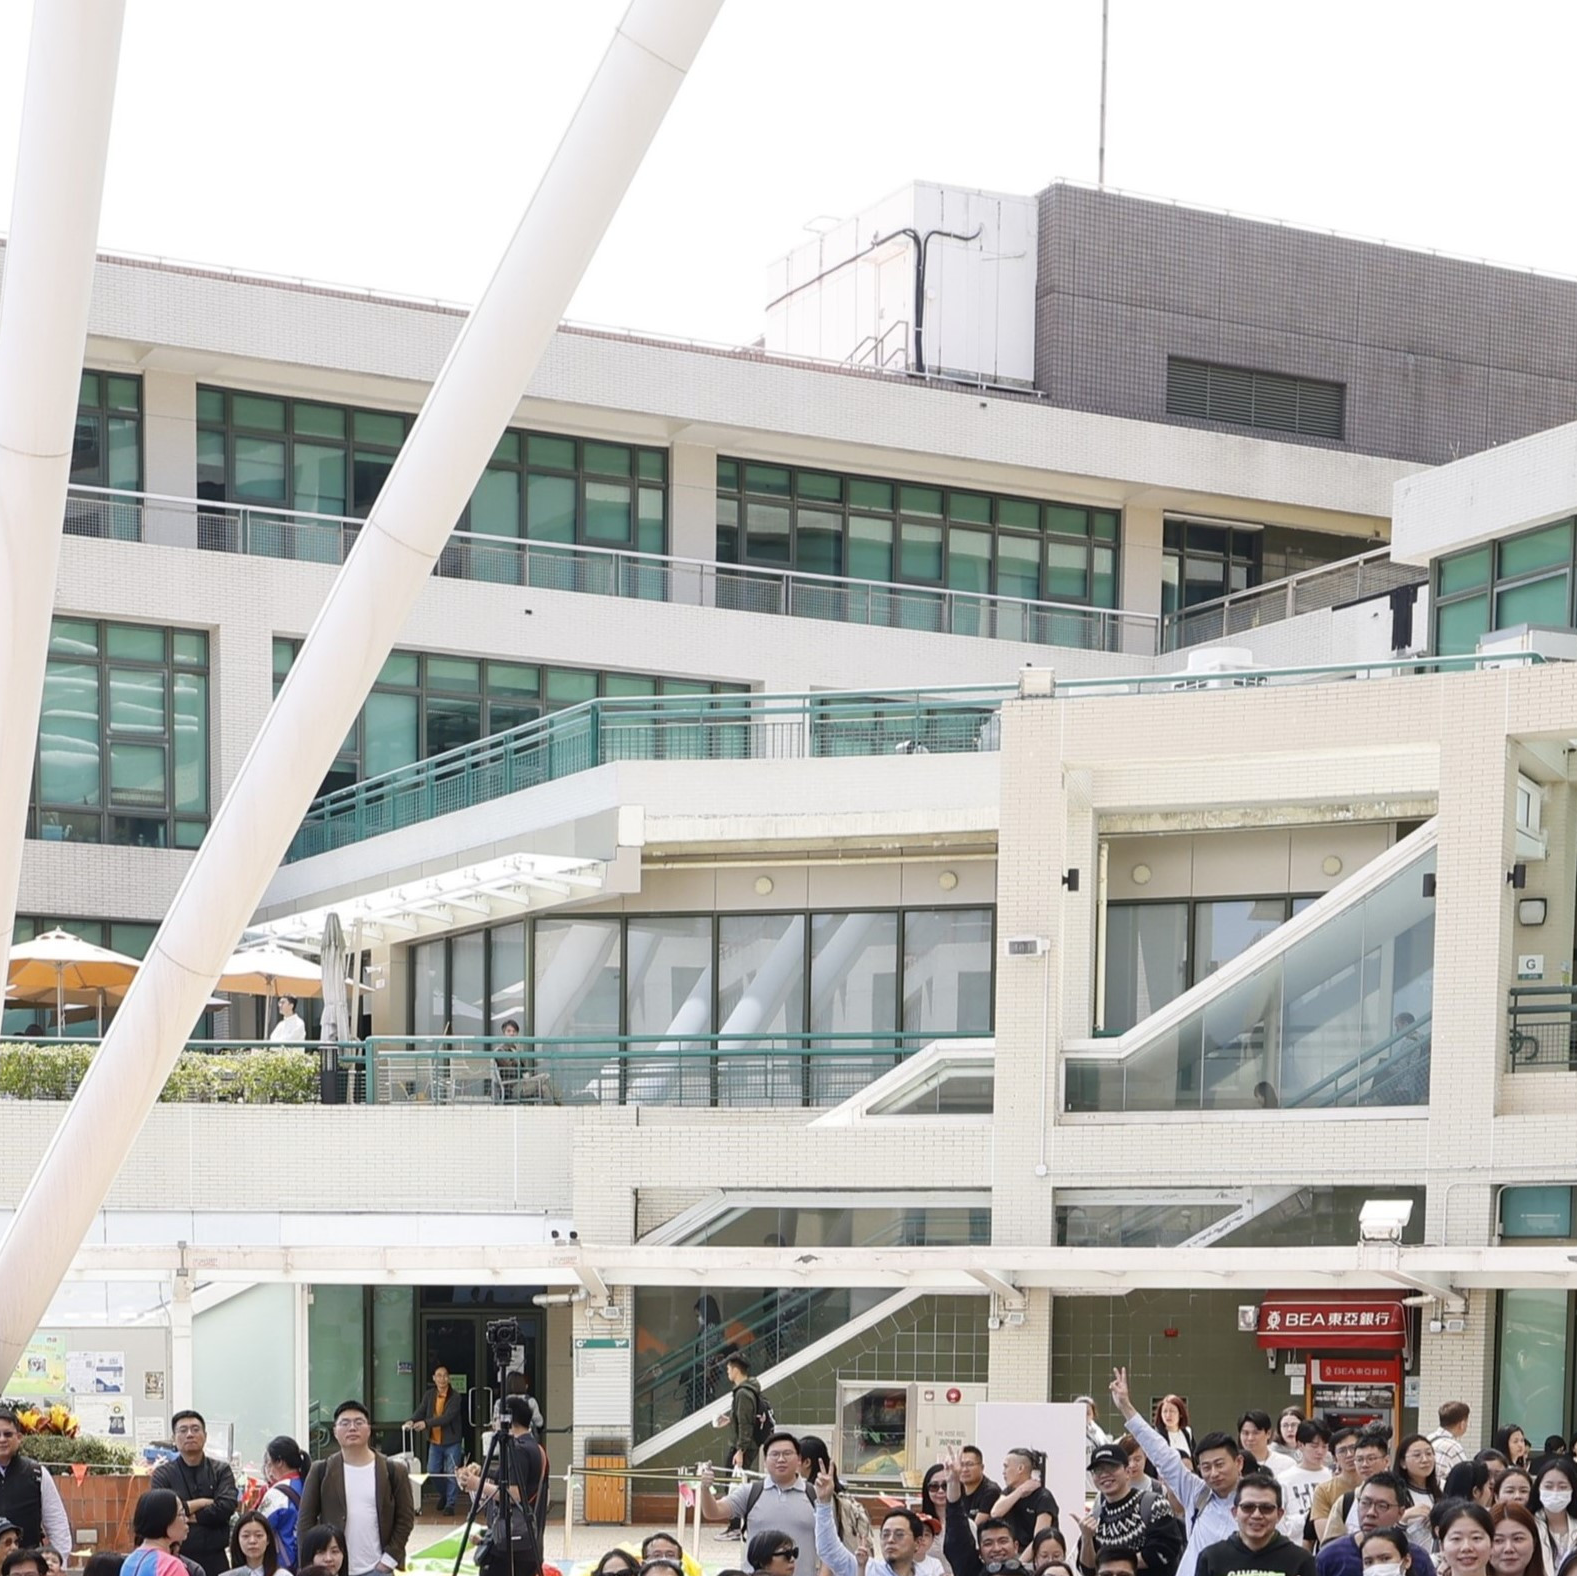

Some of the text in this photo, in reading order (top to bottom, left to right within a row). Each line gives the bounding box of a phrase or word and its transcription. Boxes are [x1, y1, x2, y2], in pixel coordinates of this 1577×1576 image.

[1285, 1311, 1390, 1326] BEA 東亞銀行
[1334, 1367, 1388, 1377] BEA 東亞銀行
